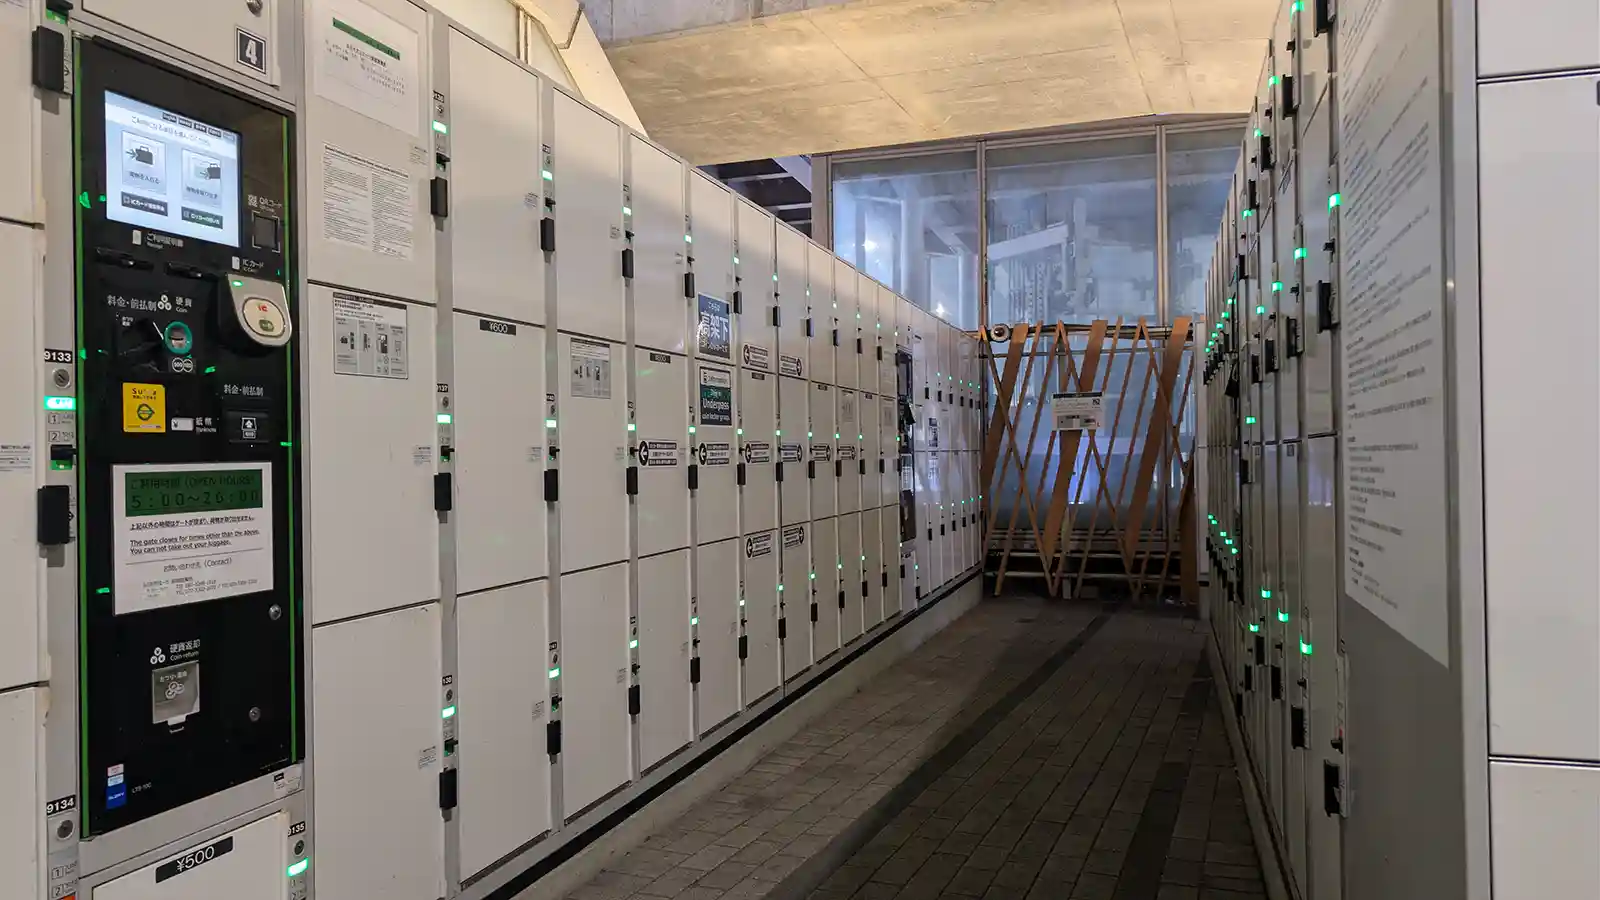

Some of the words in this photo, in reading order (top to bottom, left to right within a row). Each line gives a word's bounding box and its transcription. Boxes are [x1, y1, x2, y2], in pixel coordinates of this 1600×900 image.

[245, 39, 258, 65] 4
[489, 321, 508, 333] ¥600
[699, 310, 730, 341] 高架下
[44, 351, 72, 362] 9133
[702, 398, 730, 411] Underpass
[130, 547, 143, 555] You
[194, 542, 208, 550] your
[144, 538, 158, 547] gate
[204, 557, 232, 568] (Contact)
[47, 798, 75, 813] 9134
[177, 845, 215, 873] ¥500
